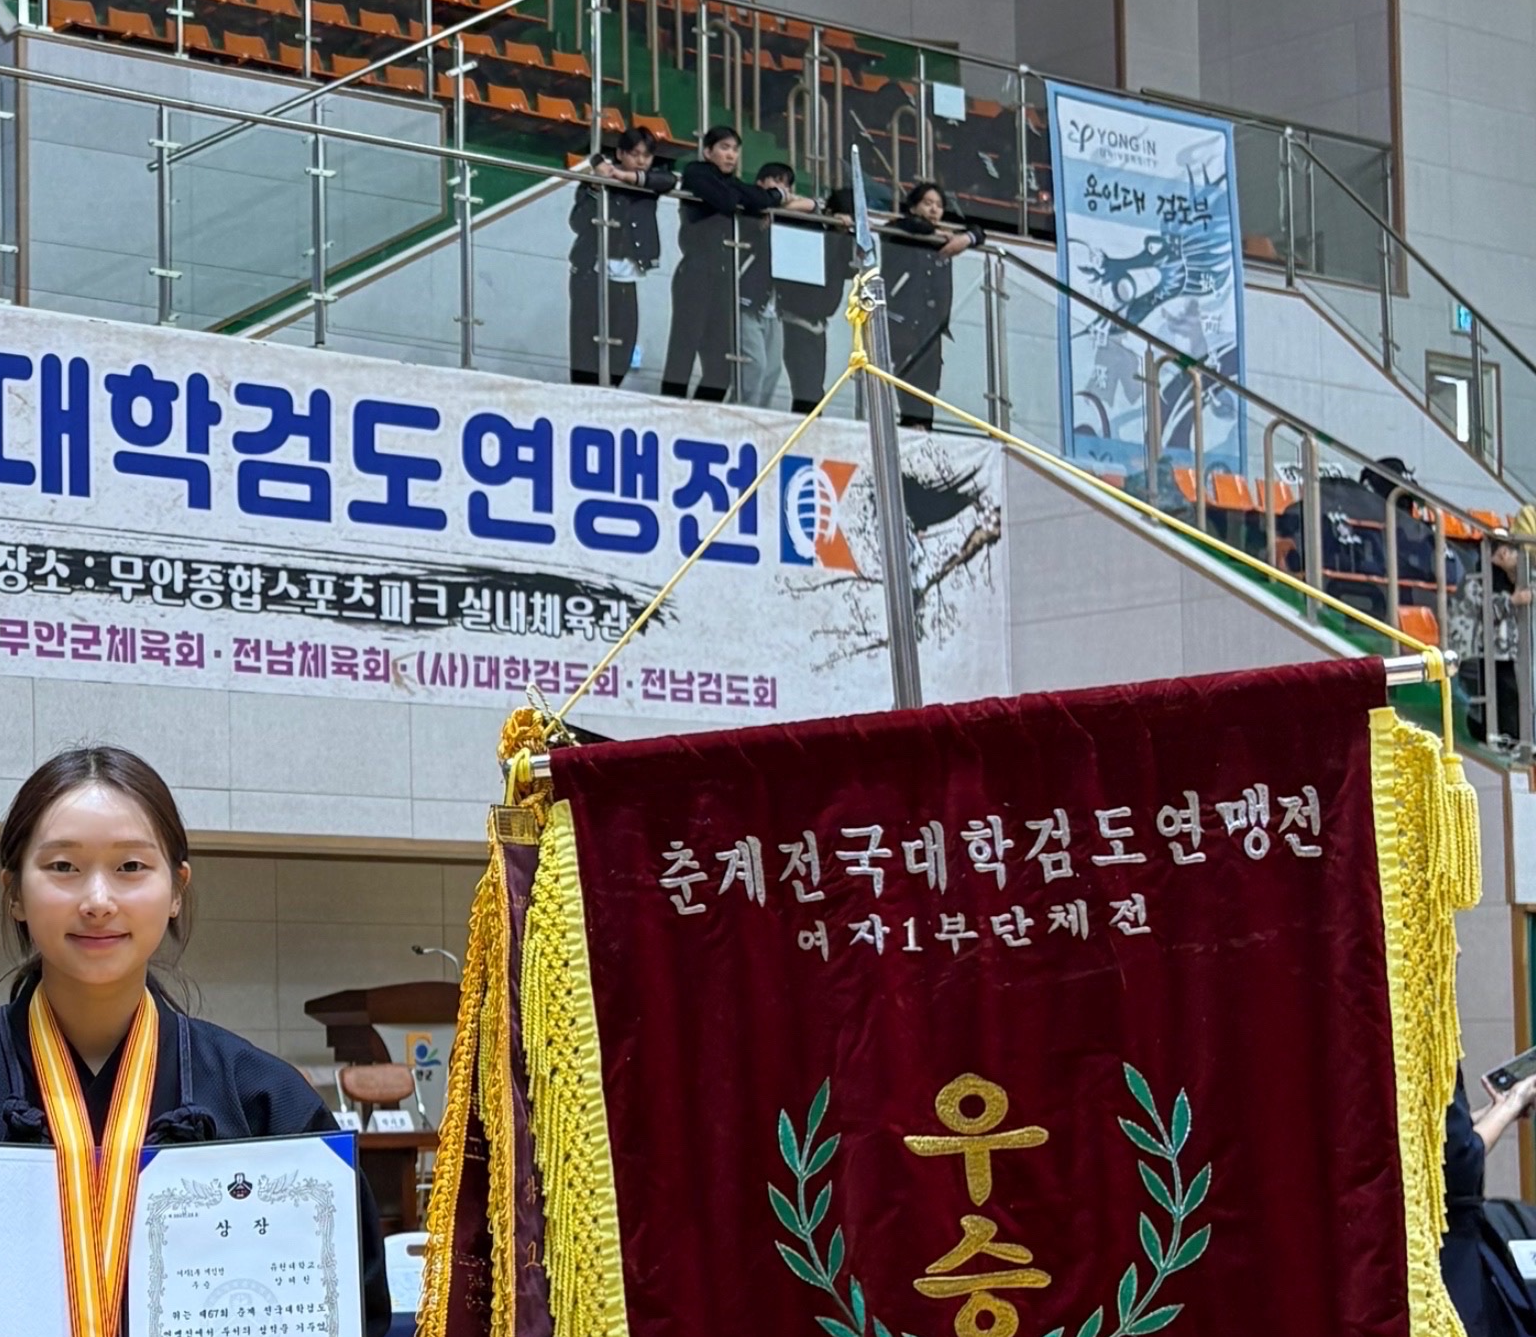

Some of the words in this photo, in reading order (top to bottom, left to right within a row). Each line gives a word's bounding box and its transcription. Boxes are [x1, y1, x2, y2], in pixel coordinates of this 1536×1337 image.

[1084, 173, 1146, 215] 용인대
[1157, 193, 1213, 231] 검도부
[107, 553, 449, 627] 무안종합스포츠파크
[458, 585, 635, 642] 실내체육관
[658, 783, 1324, 916] 춘계전국대학검도연맹전
